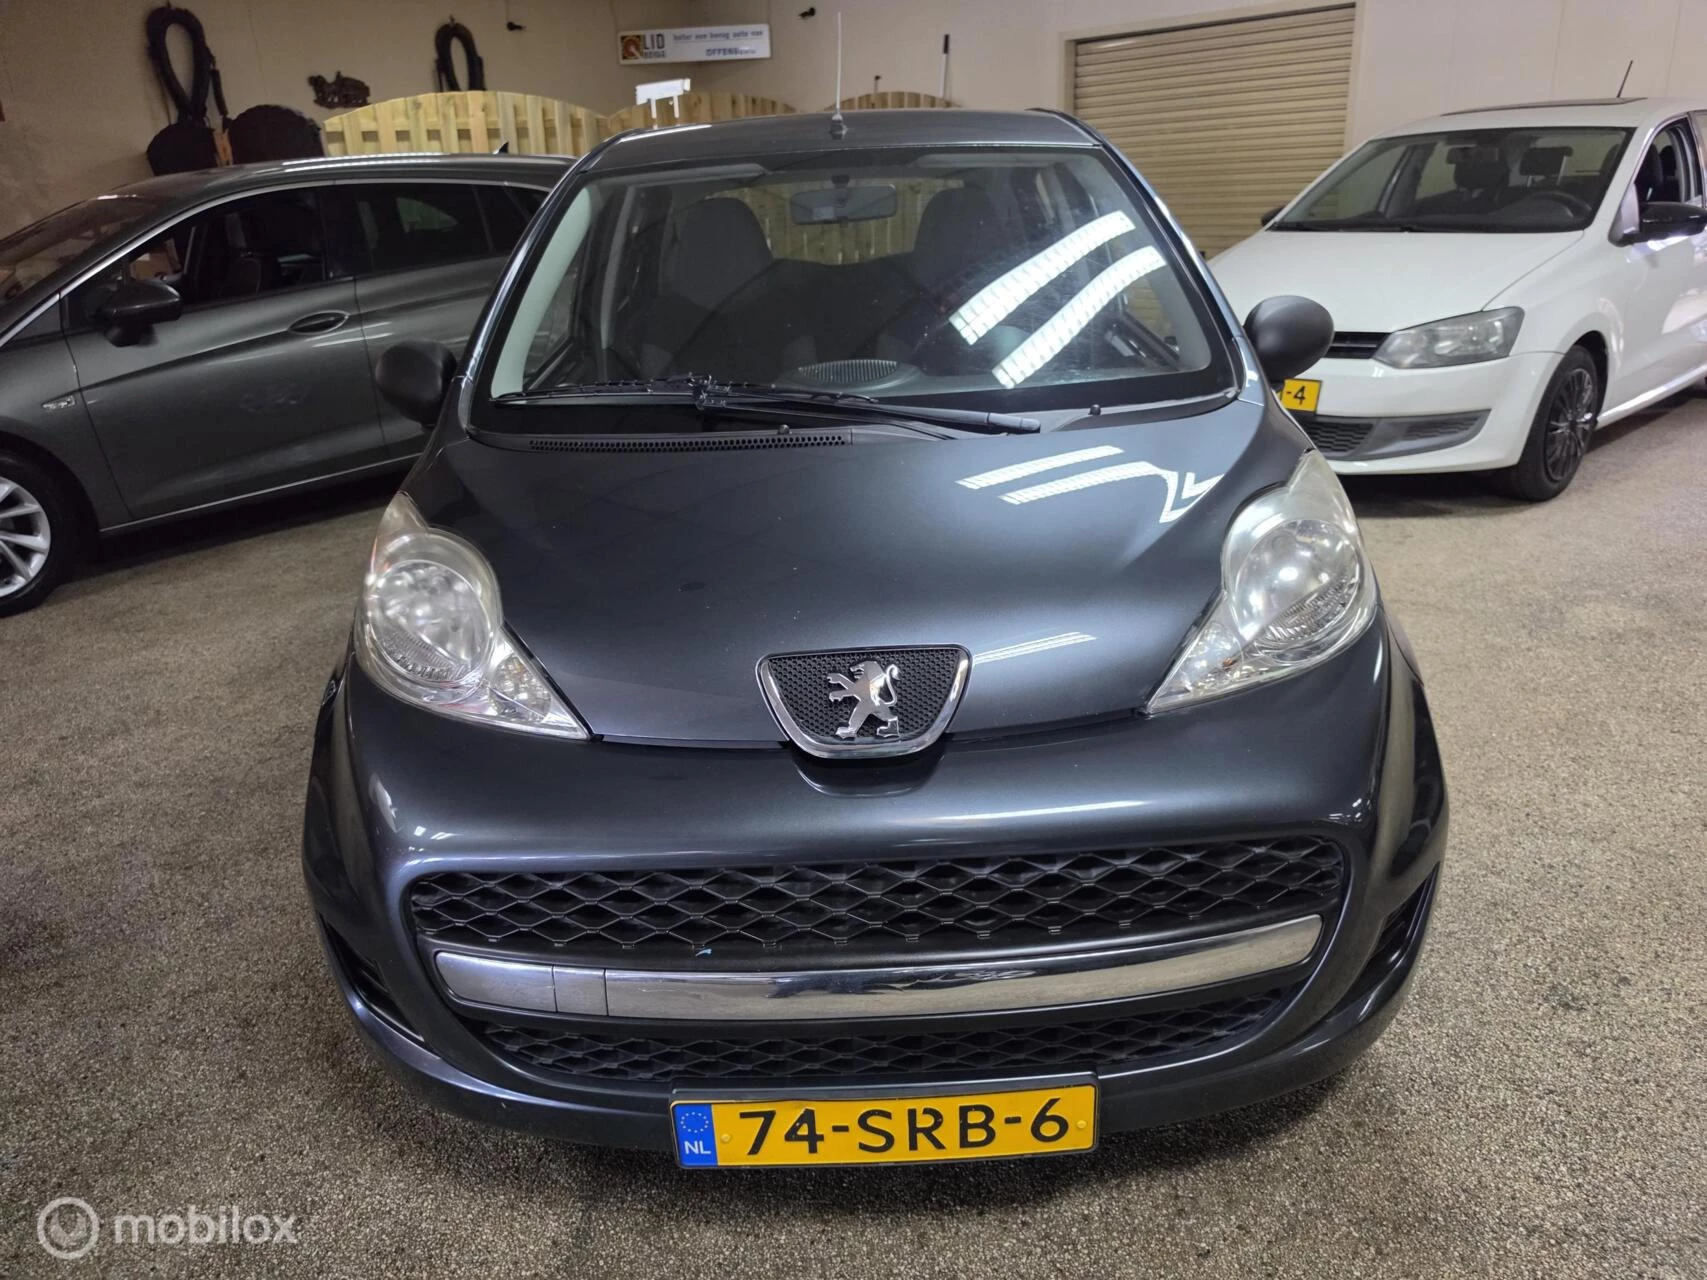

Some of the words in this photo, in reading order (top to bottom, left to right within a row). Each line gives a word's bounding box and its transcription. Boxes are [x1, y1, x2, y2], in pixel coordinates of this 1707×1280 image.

[642, 33, 665, 50] LID
[1280, 385, 1306, 406] -4
[739, 1098, 1070, 1156] 74-SRB-6
[684, 1140, 711, 1156] NL
